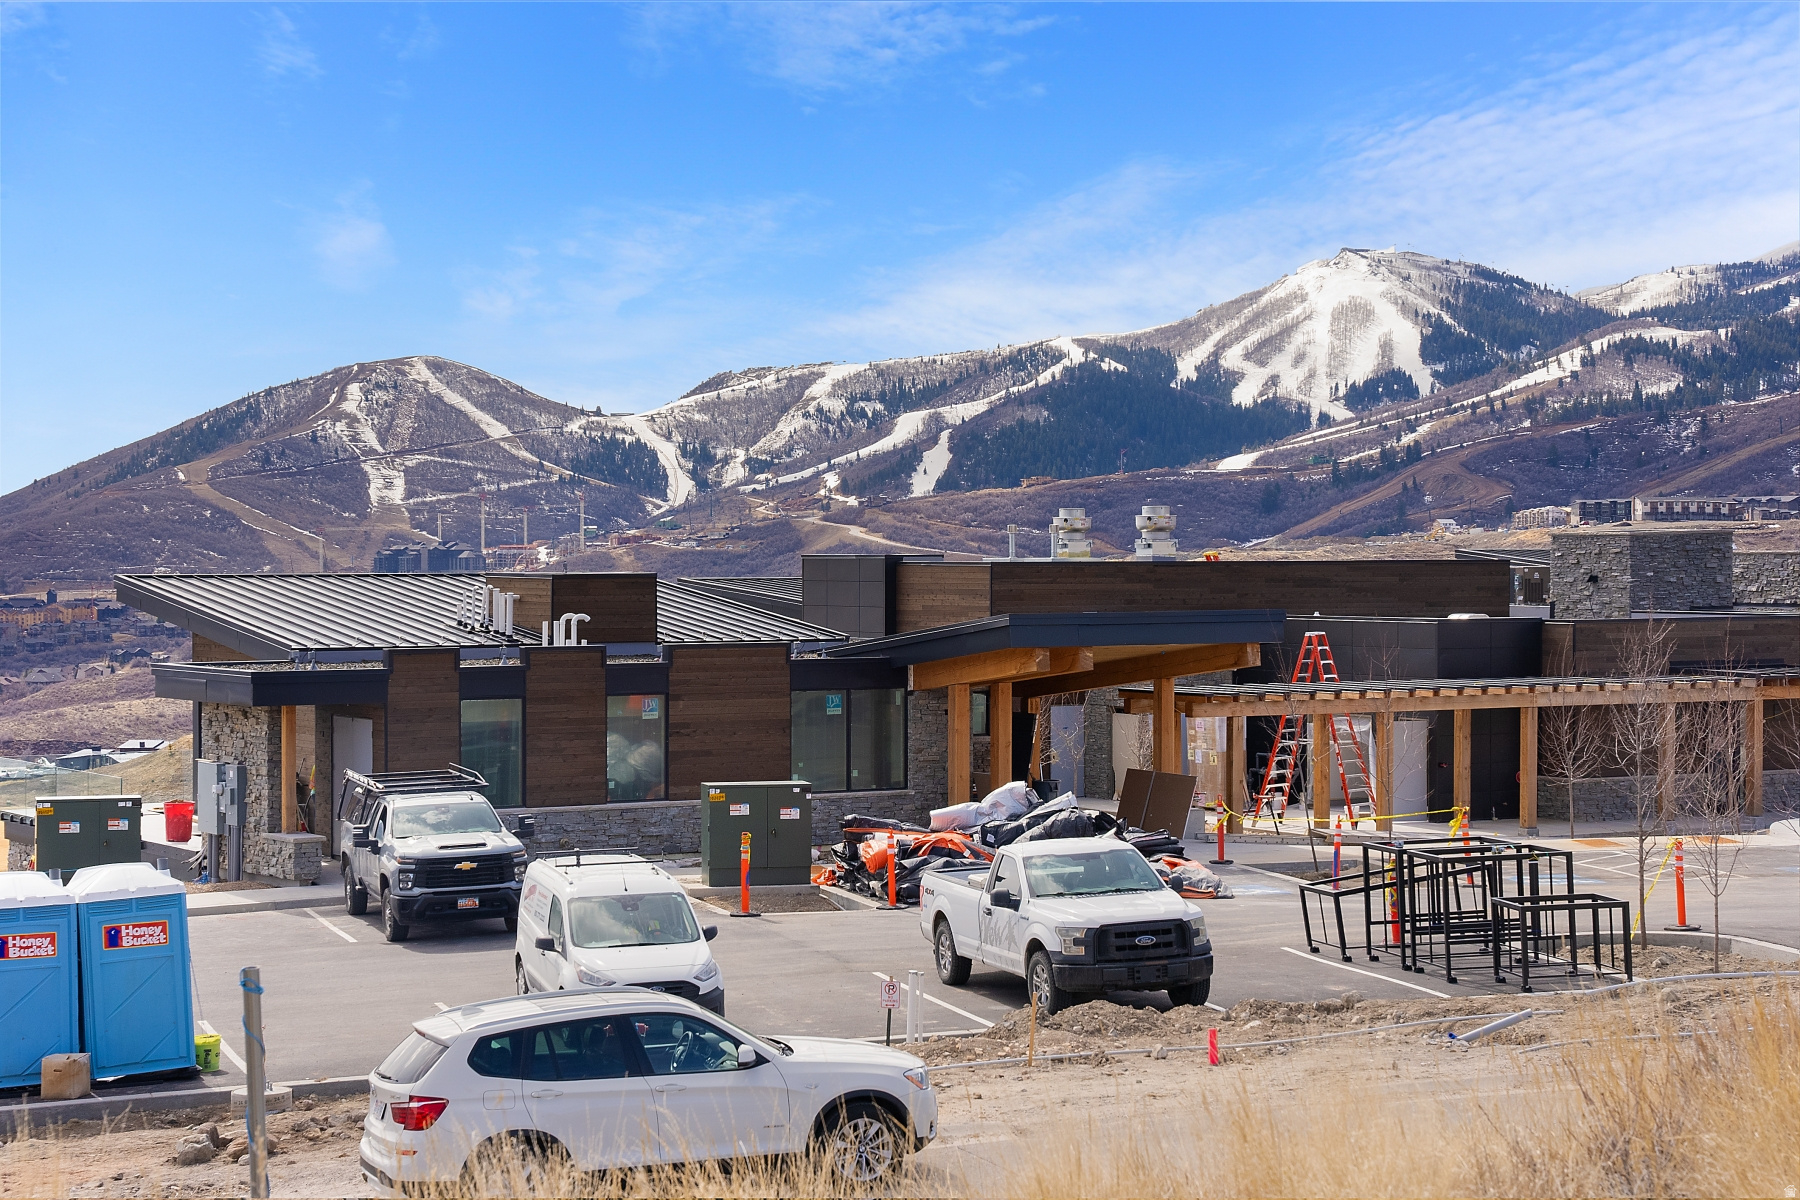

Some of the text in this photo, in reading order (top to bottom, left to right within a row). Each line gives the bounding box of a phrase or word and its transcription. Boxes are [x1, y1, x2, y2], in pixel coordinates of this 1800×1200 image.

[121, 925, 163, 937] Honey
[8, 936, 51, 948] Honey
[122, 933, 167, 946] Bucket
[8, 944, 55, 958] Bucket
